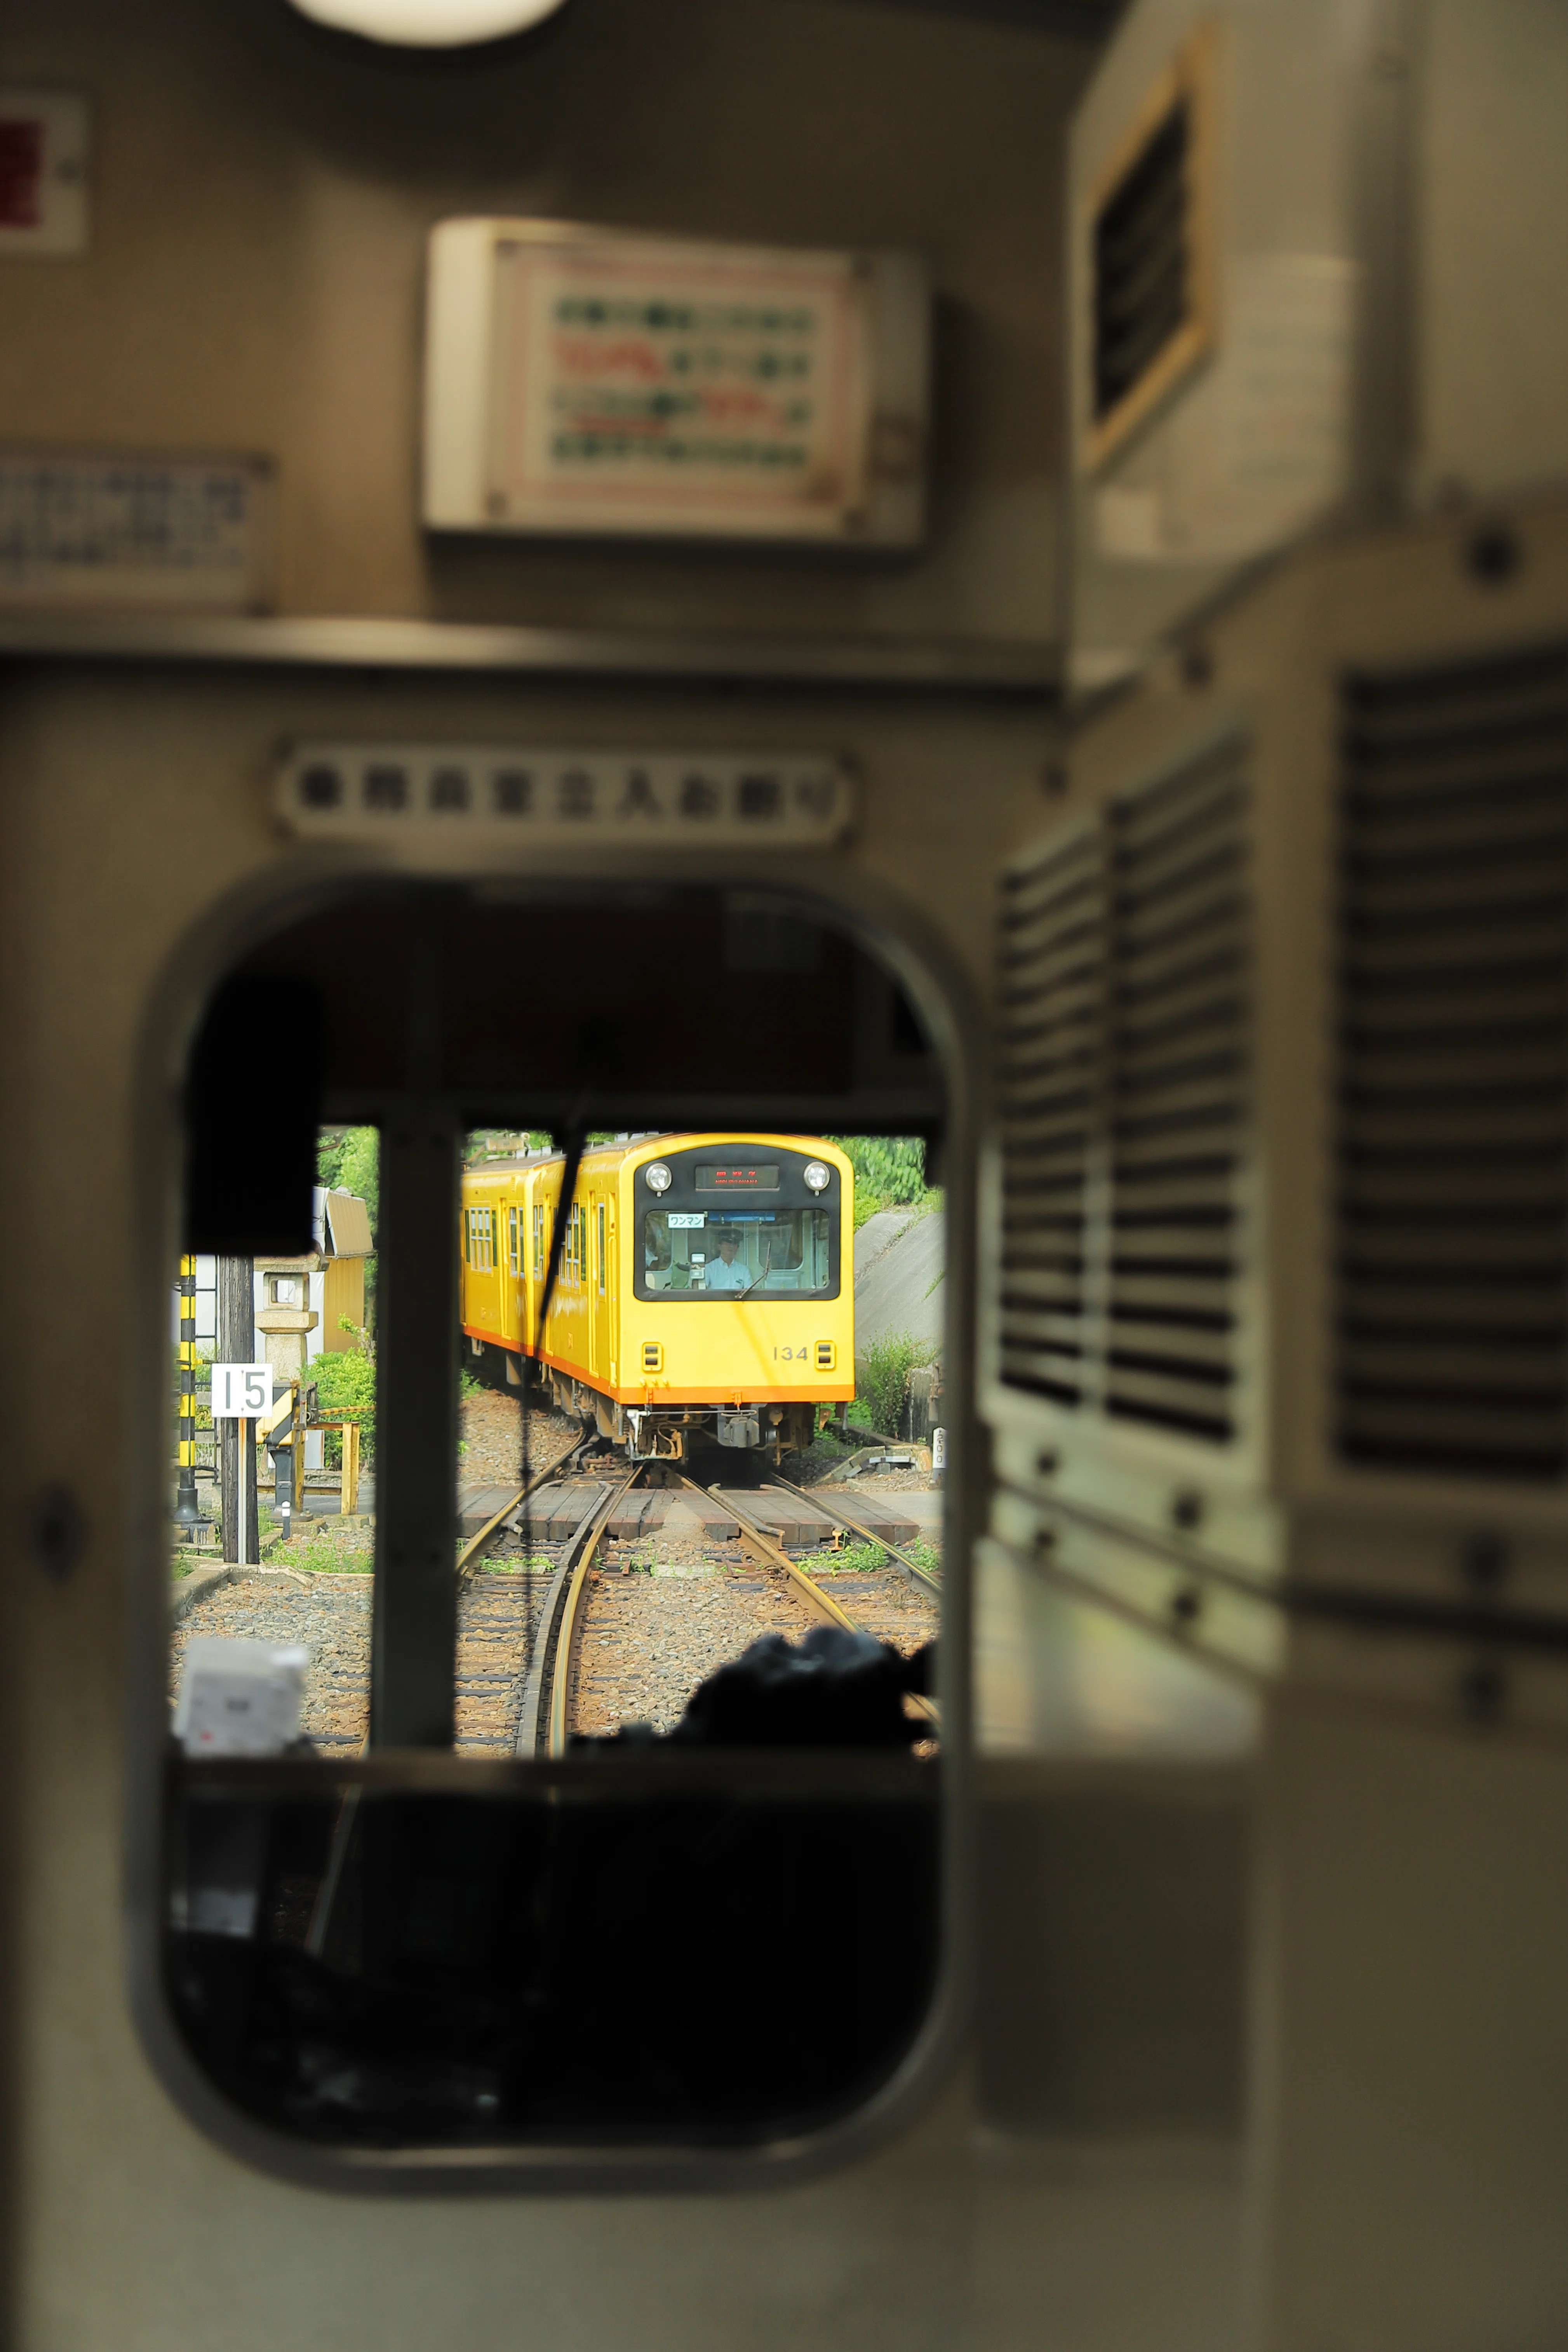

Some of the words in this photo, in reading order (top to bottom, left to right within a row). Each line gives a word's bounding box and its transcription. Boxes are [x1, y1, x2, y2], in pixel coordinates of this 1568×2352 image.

[671, 1217, 702, 1225] ワンマン
[774, 1346, 808, 1360] 134
[226, 1371, 265, 1409] 15
